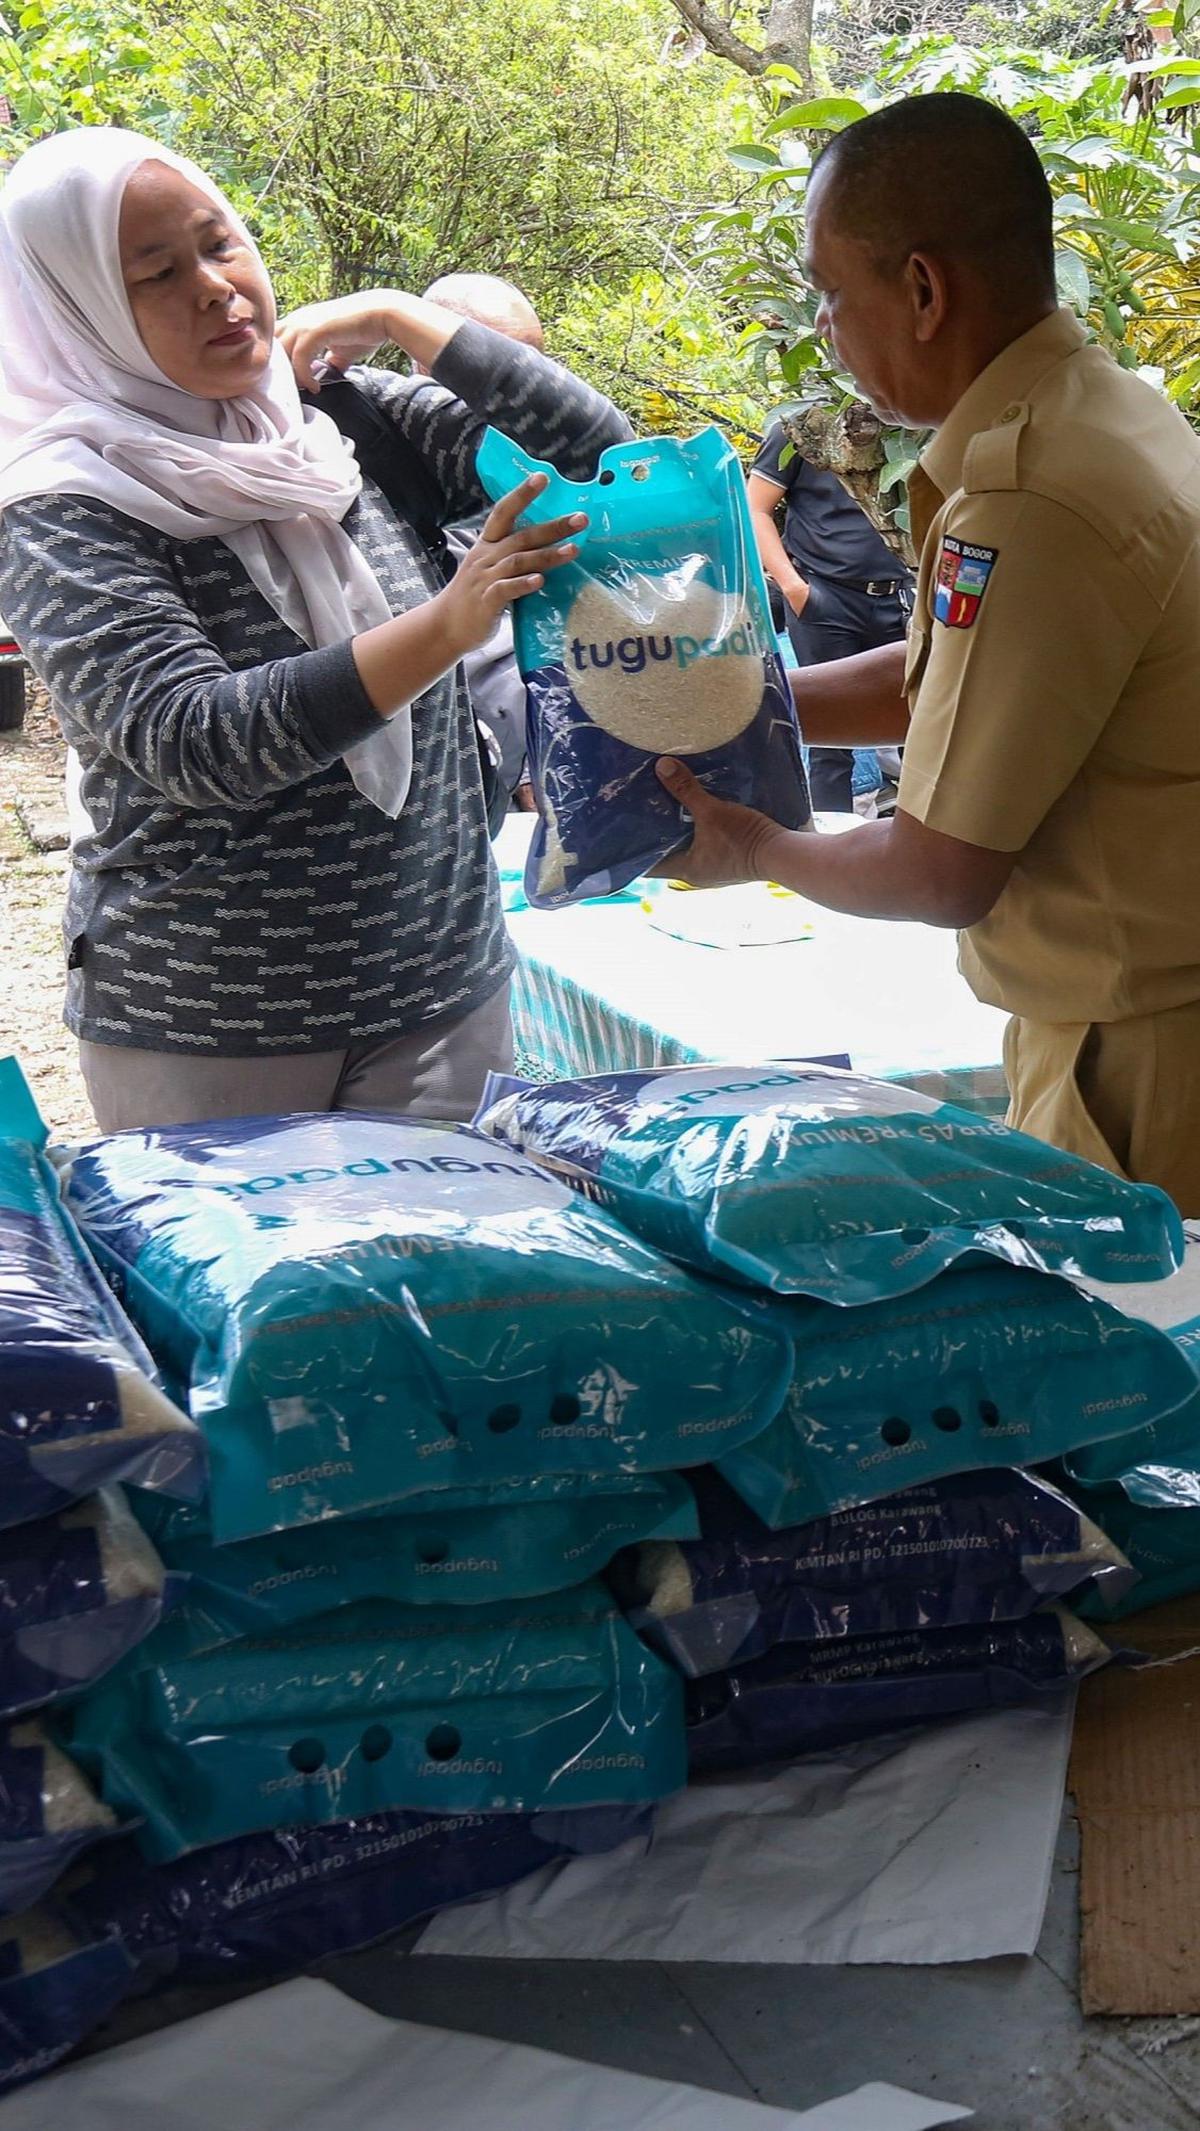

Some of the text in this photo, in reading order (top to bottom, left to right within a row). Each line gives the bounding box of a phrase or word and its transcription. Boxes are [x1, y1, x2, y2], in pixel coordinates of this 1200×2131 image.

[961, 545, 994, 561] BOGOR
[570, 622, 756, 674] tugupadi
[916, 1120, 1011, 1144] BERAS
[537, 1423, 615, 1441] tugupadi
[267, 1460, 355, 1494] tugupadi
[831, 1508, 876, 1527] BULOG
[849, 1551, 861, 1562] RI
[415, 1557, 499, 1576] tugupadi
[418, 1758, 503, 1777] tugupadi
[302, 1863, 318, 1880] RI
